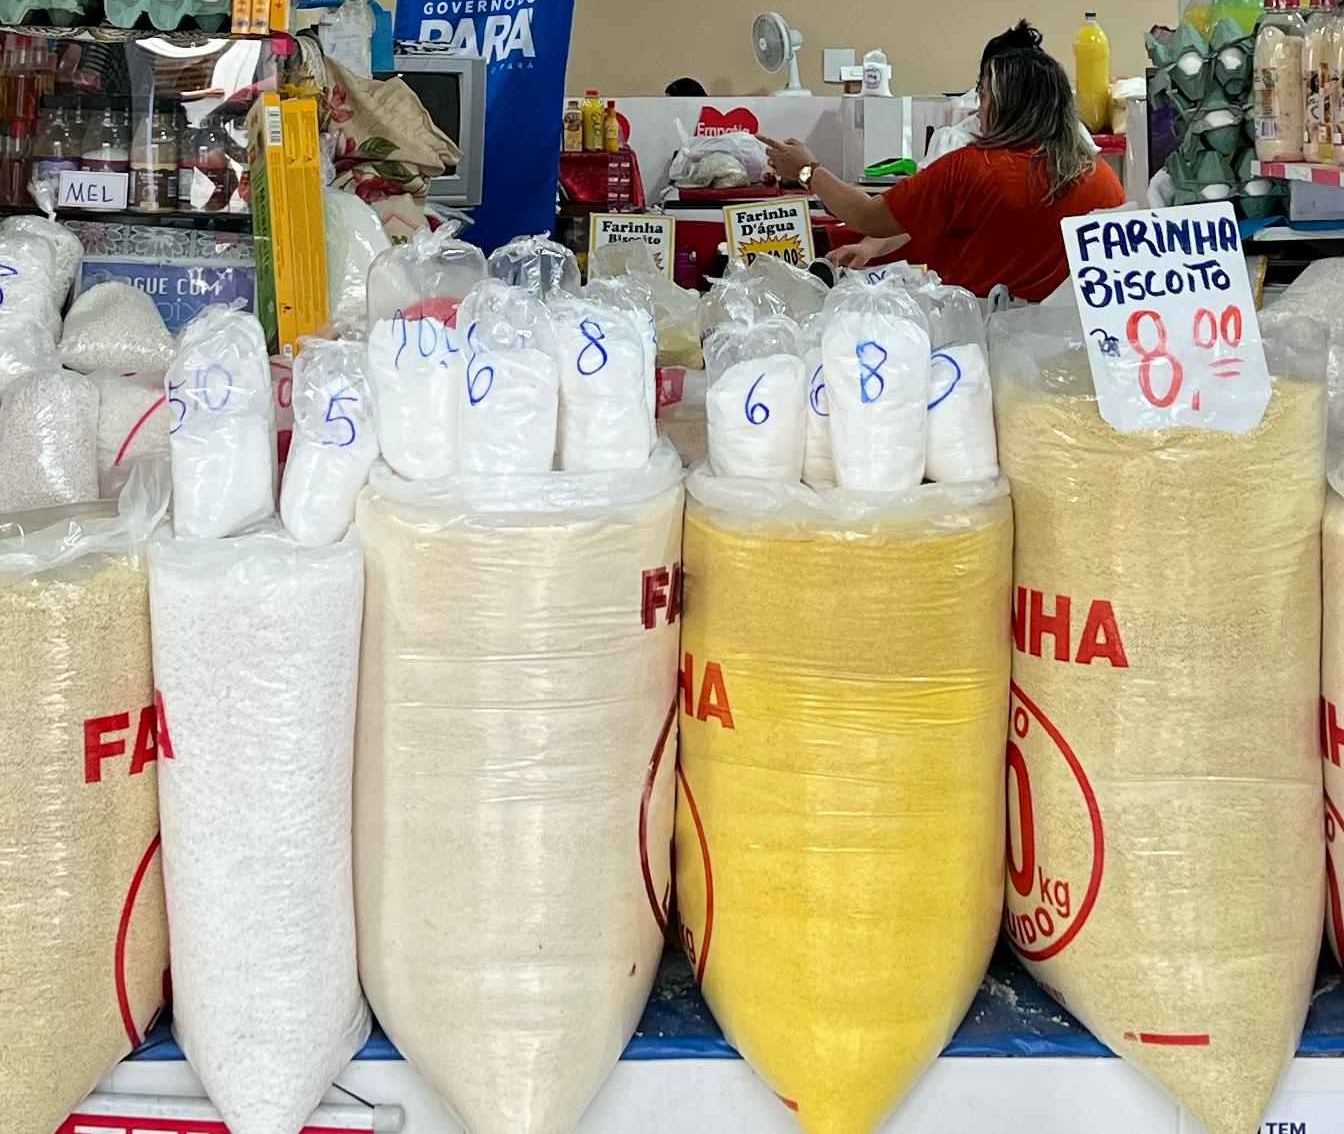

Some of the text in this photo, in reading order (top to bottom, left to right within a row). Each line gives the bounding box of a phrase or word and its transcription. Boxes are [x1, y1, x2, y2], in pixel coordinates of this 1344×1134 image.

[418, 7, 536, 65] PARÁ
[65, 181, 114, 203] MEL
[736, 207, 798, 224] Farinha
[602, 221, 664, 234] Farinha
[741, 222, 795, 237] D'água
[1076, 213, 1238, 261] FARINHA
[1078, 259, 1231, 308] BISCOITO
[577, 318, 607, 375] 8
[856, 341, 888, 403] 8
[319, 394, 359, 447] 5
[745, 372, 770, 425] 6
[1038, 868, 1071, 918] kg
